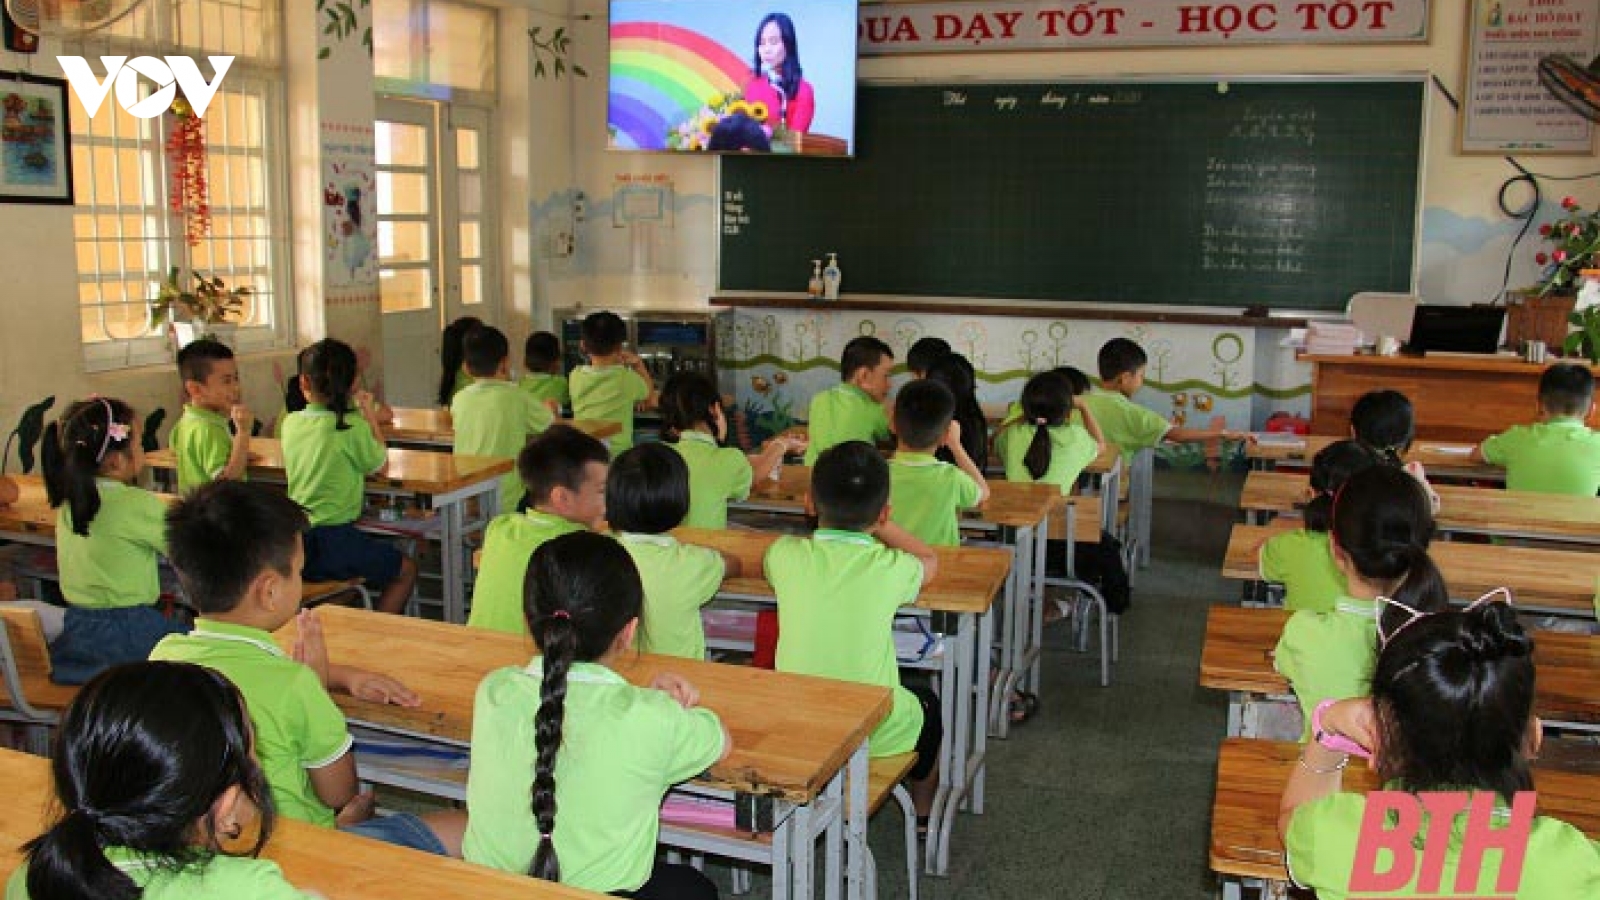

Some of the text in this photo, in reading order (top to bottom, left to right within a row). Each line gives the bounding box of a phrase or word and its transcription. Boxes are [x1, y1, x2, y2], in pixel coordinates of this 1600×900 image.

[858, 14, 920, 43] UA
[934, 12, 1023, 45] DẠY
[1038, 2, 1125, 38] TỐT
[1177, 4, 1277, 38] HỌC
